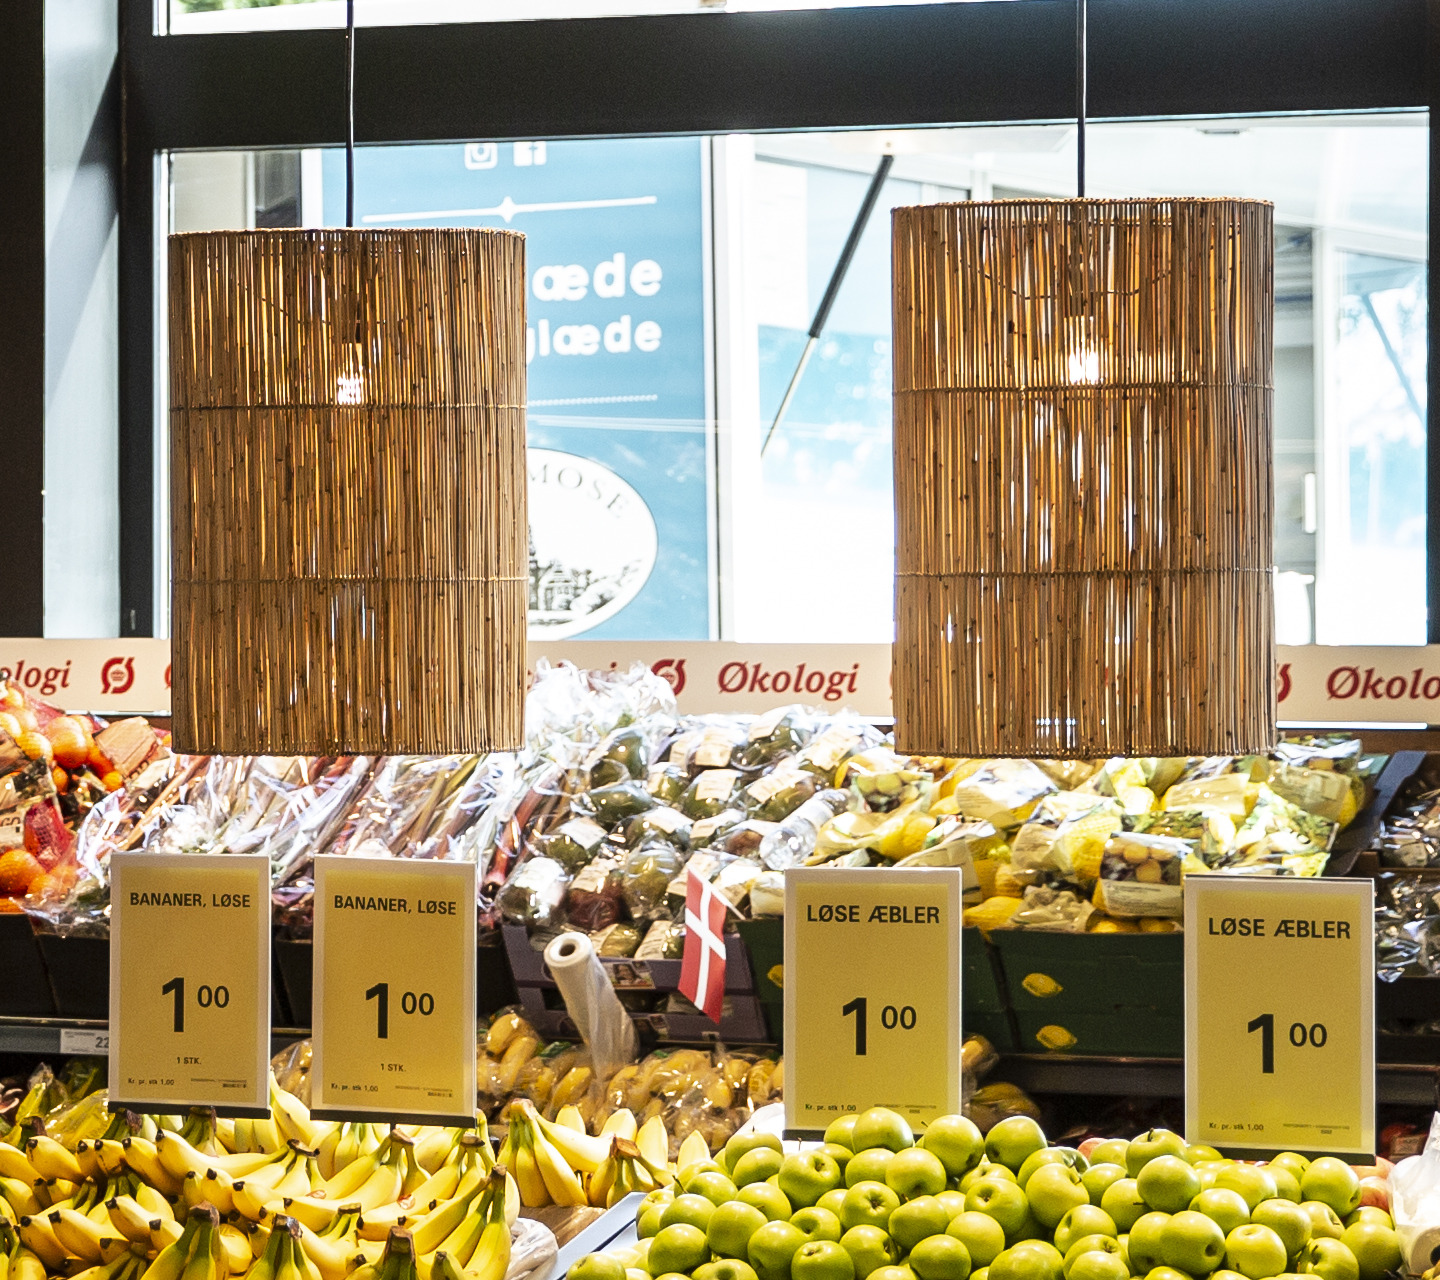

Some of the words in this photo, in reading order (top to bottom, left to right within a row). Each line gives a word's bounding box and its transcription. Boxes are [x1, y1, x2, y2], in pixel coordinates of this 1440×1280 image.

[718, 661, 860, 702] Økologi
[130, 892, 207, 908] BANANER,
[212, 893, 251, 908] LØSE
[334, 895, 413, 915] BANANER,
[417, 899, 457, 916] LØSE
[807, 904, 860, 923] LØSE
[867, 906, 940, 924] ÆBLER
[1208, 917, 1266, 937] LØSE
[1273, 919, 1351, 939] ÆBLER
